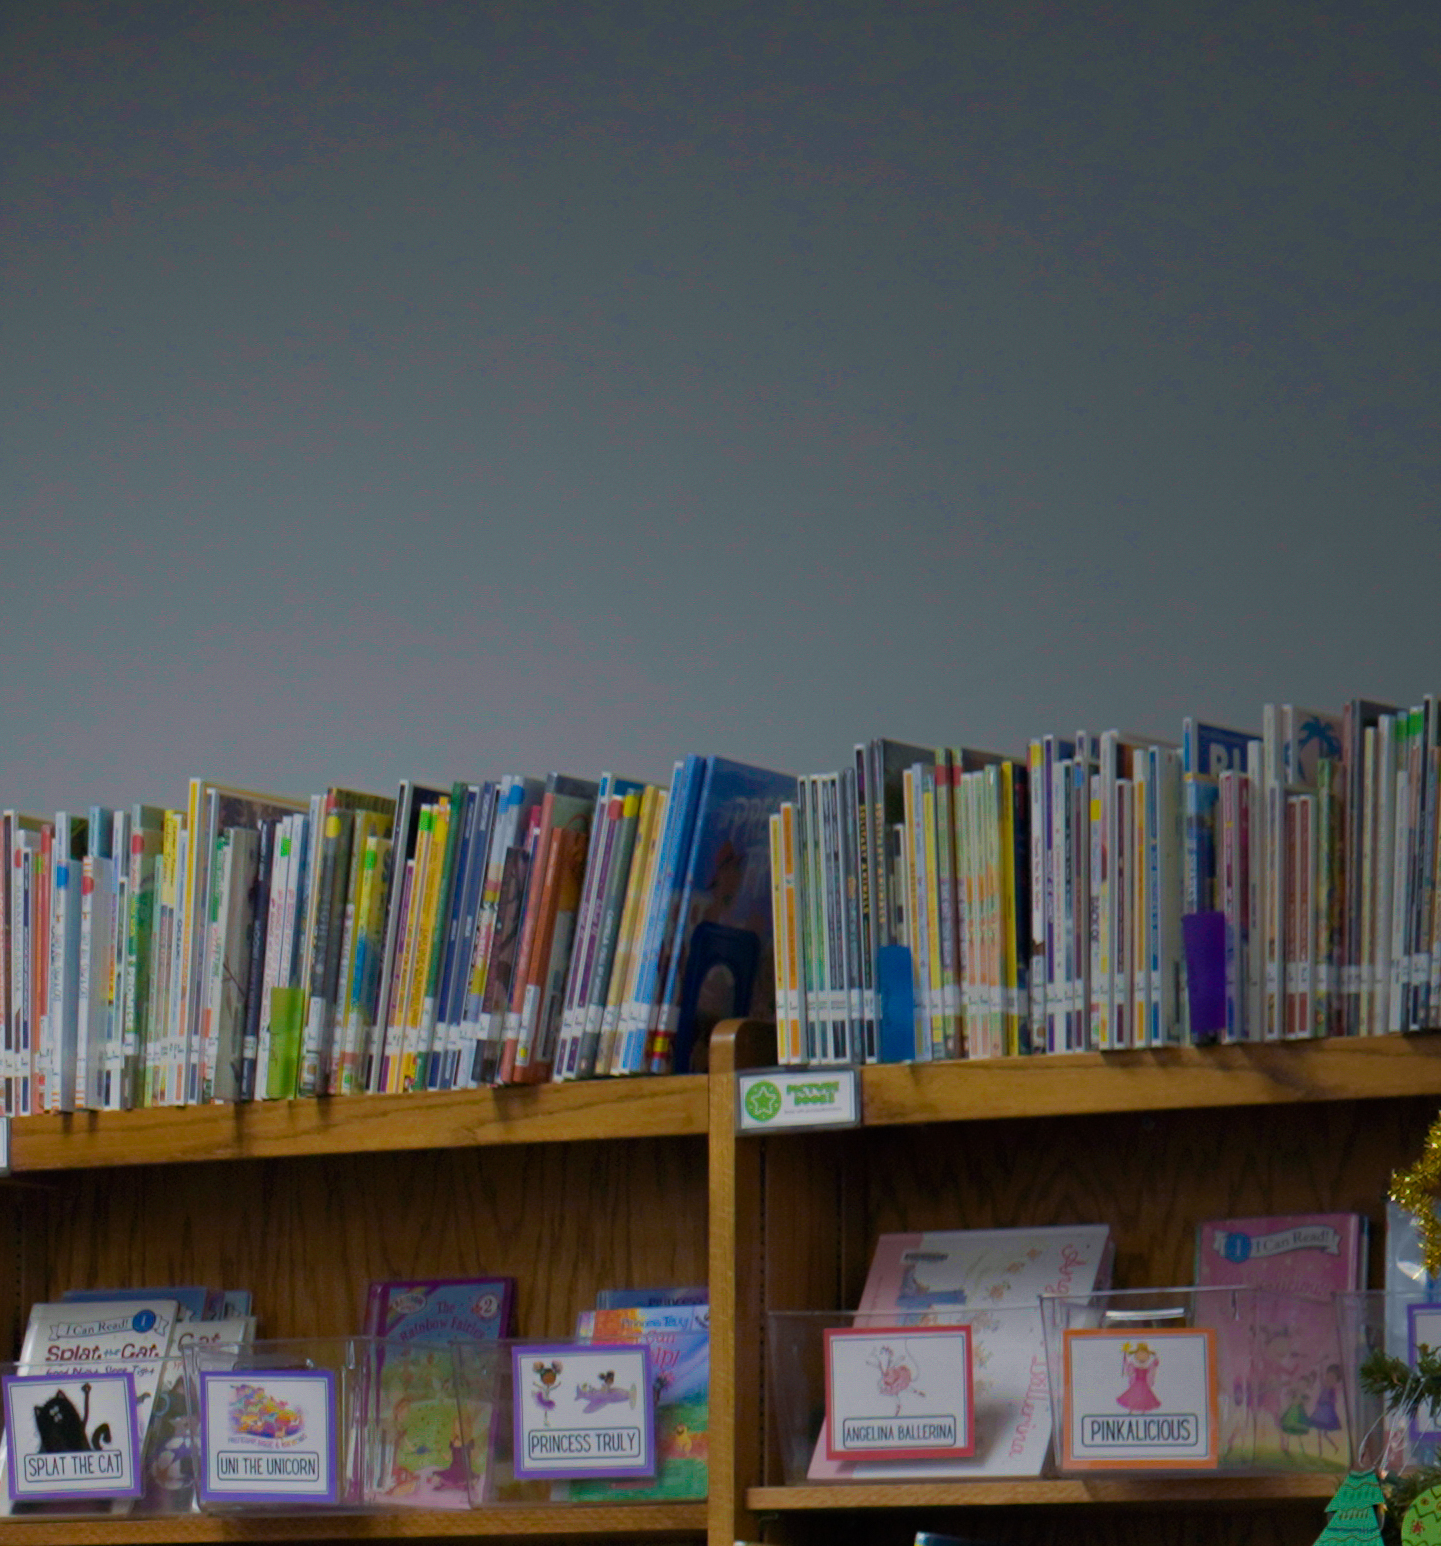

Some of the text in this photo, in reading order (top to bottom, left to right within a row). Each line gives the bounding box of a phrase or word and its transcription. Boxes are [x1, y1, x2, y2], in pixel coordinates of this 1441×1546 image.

[1264, 1237, 1290, 1253] Can
[1292, 1230, 1331, 1245] Read!
[73, 1323, 96, 1336] Can
[98, 1318, 130, 1333] Read!
[846, 1422, 954, 1441] ANGELINA BALLERINA
[1090, 1420, 1191, 1442] PINKALICIOUS
[531, 1431, 637, 1454] PRINCESS TRULY
[28, 1453, 121, 1476] SPLAT THE CAT
[220, 1457, 316, 1476] UNI THE UNICORN
